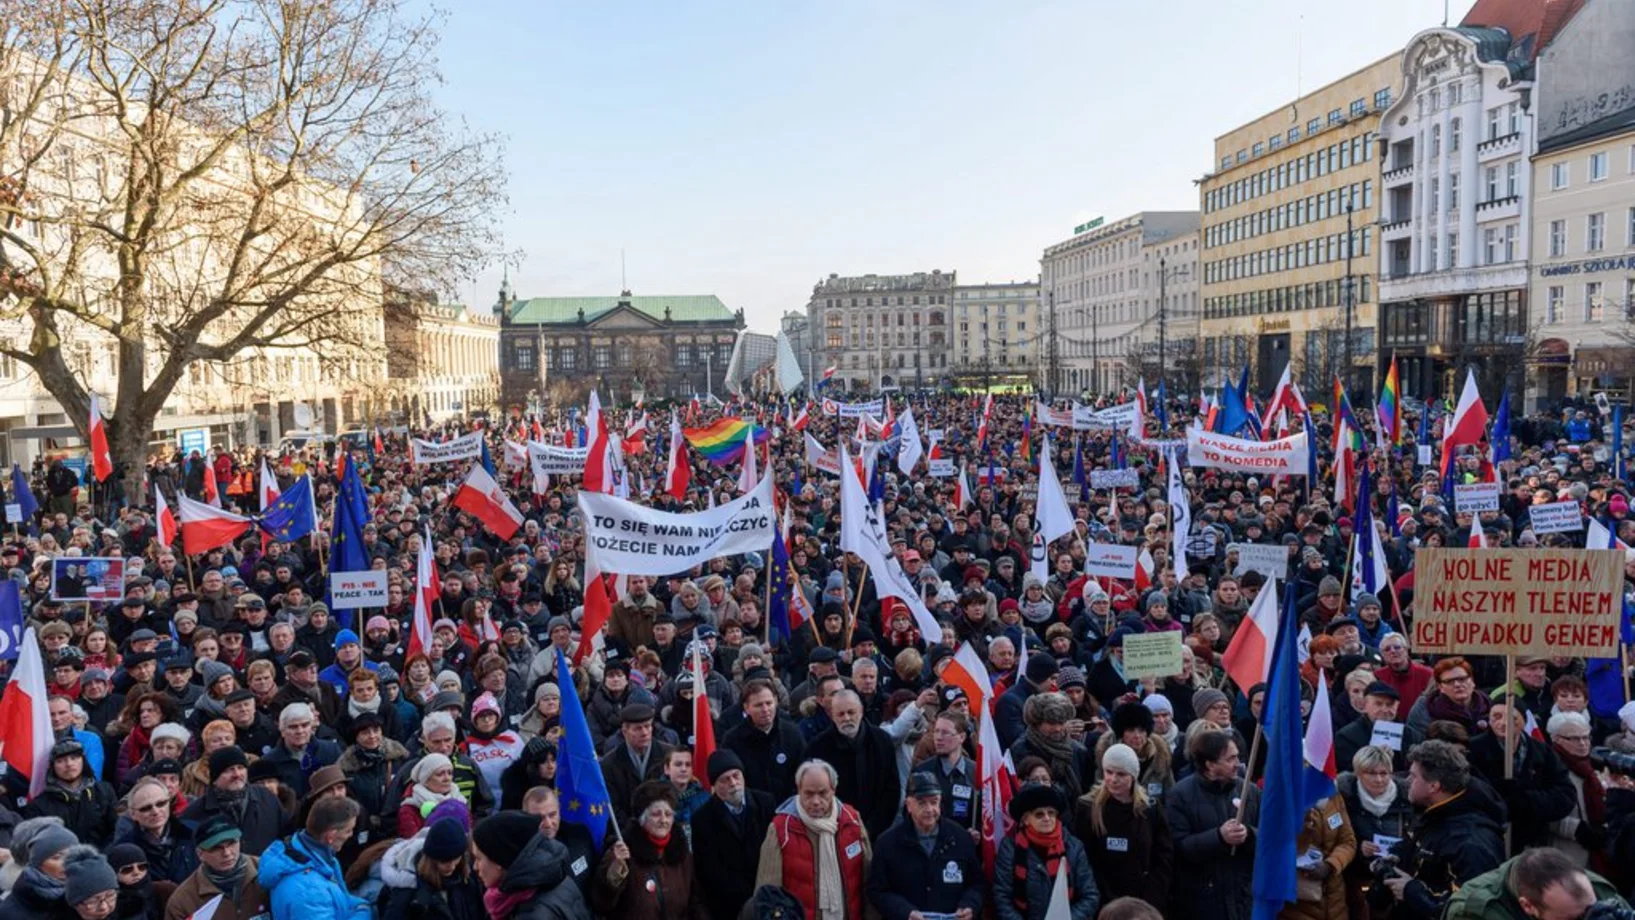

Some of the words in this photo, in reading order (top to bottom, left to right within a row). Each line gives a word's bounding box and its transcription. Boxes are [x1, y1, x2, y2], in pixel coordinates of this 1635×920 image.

[1203, 451, 1220, 462] TO
[1224, 455, 1288, 467] KOMEDIA
[1458, 503, 1469, 511] go
[593, 515, 615, 529] TO
[620, 519, 649, 536] SIĘ
[654, 524, 693, 537] WAM
[727, 513, 768, 533] CZYĆ
[592, 535, 657, 555] OŻECIE
[663, 543, 700, 556] NAM
[1443, 558, 1512, 581] WOLNE
[1528, 559, 1591, 582] MEDIA
[334, 591, 361, 599] PEACE
[1433, 590, 1515, 613] NASZYM
[1527, 591, 1612, 614] TLENEM
[1416, 622, 1447, 645] ICH
[1456, 623, 1533, 645] UPADKU
[1545, 624, 1614, 647] GENEM
